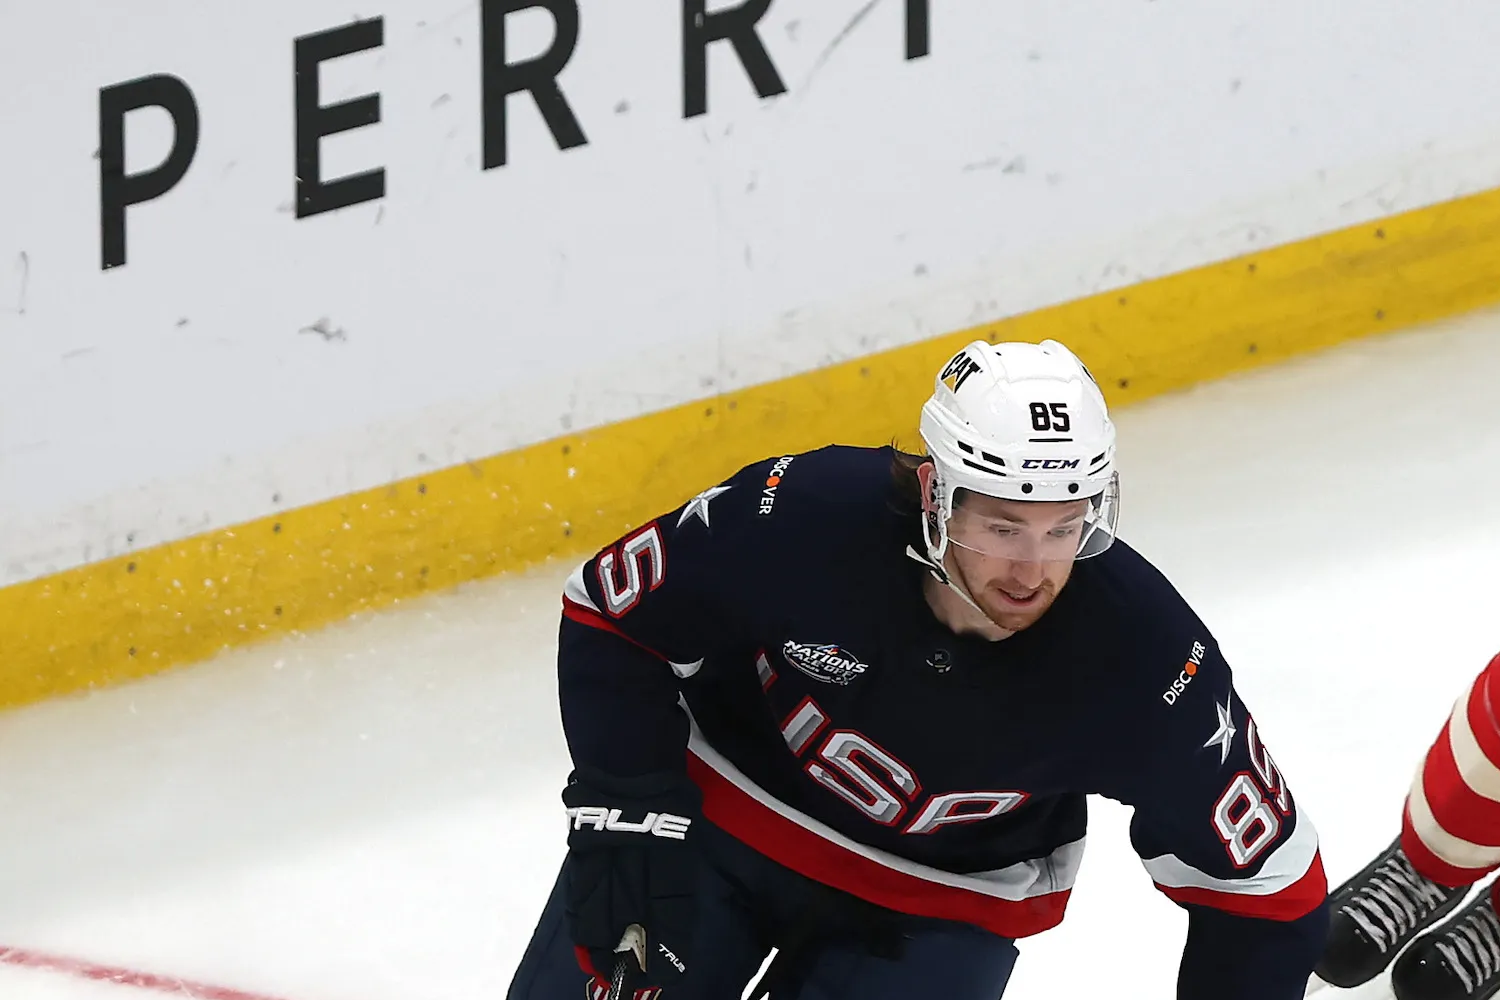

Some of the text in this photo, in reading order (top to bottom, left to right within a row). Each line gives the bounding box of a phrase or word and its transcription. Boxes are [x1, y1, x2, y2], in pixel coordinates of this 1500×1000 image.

[99, 0, 929, 271] PERR
[940, 351, 982, 394] CAT
[1029, 402, 1071, 432] 85
[758, 456, 795, 516] DISCOVER
[1021, 459, 1081, 470] CCM
[784, 640, 869, 673] NATIONS
[1162, 640, 1206, 706] DISCOVER
